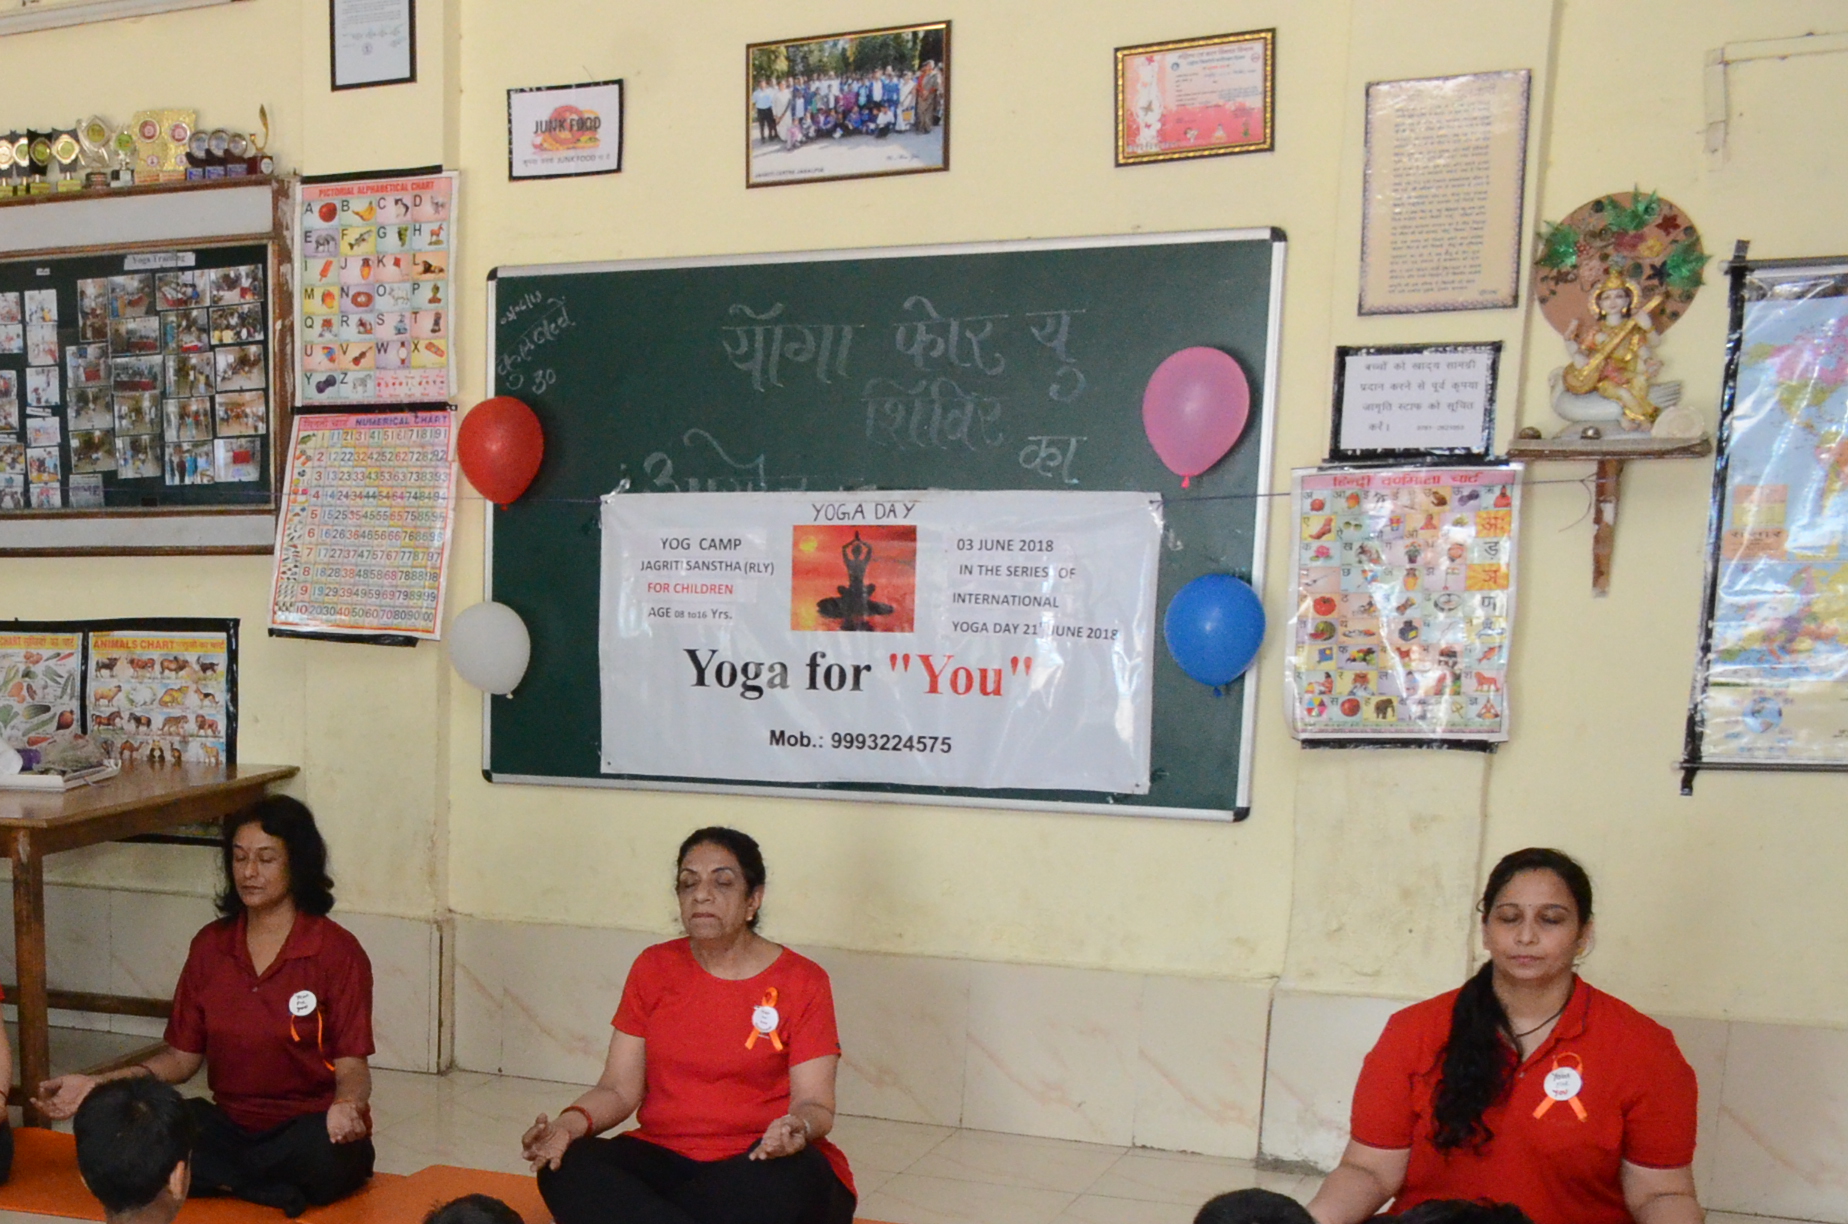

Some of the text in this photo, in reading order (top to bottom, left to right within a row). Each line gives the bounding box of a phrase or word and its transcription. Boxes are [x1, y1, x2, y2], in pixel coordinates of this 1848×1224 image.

[534, 116, 601, 134] JUNK FOOD
[319, 181, 435, 197] PICTORIAL ALPHABETICAL CHART
[341, 200, 350, 212] B
[377, 197, 387, 210] C
[414, 195, 422, 207] D
[304, 203, 313, 214] A
[341, 229, 348, 240] F
[377, 226, 387, 238] G
[413, 225, 421, 236] H
[304, 231, 312, 243] E
[340, 258, 347, 270] J
[377, 255, 386, 267] K
[412, 254, 420, 265] L
[304, 288, 314, 300] M
[341, 287, 349, 299] N
[376, 285, 386, 297] O
[412, 283, 420, 295] P
[304, 317, 314, 329] Q
[341, 315, 349, 327] R
[376, 314, 385, 325] S
[412, 312, 419, 324] T
[304, 345, 313, 357] U
[340, 344, 349, 355] V
[376, 343, 388, 354] W
[412, 341, 420, 353] X
[304, 373, 312, 385] Y
[340, 373, 348, 384] Z
[355, 416, 410, 426] NUMERICAL
[414, 415, 447, 424] CHART
[811, 502, 916, 522] YOGA DAY
[660, 538, 742, 551] YOG CAMP
[956, 539, 1054, 552] 03 JUNE 2018
[640, 559, 775, 576] JAGRITI SANSTHA (RLY)
[959, 564, 1076, 579] IN THE SERIES OF
[648, 583, 734, 595] FOR CHILDREN
[952, 593, 1059, 608] INTERNATIONAL
[648, 607, 672, 618] AGE
[674, 610, 685, 619] 08
[710, 608, 733, 620] Yrs.
[952, 621, 989, 634] YOGA
[993, 623, 1019, 635] DAY
[1087, 627, 1119, 640] 2018
[0, 636, 21, 647] CHART
[93, 638, 138, 649] ANIMALS
[140, 639, 175, 650] CHART
[683, 648, 1034, 700] Yoga for "You"
[769, 729, 952, 753] Mob.: 9993224575
